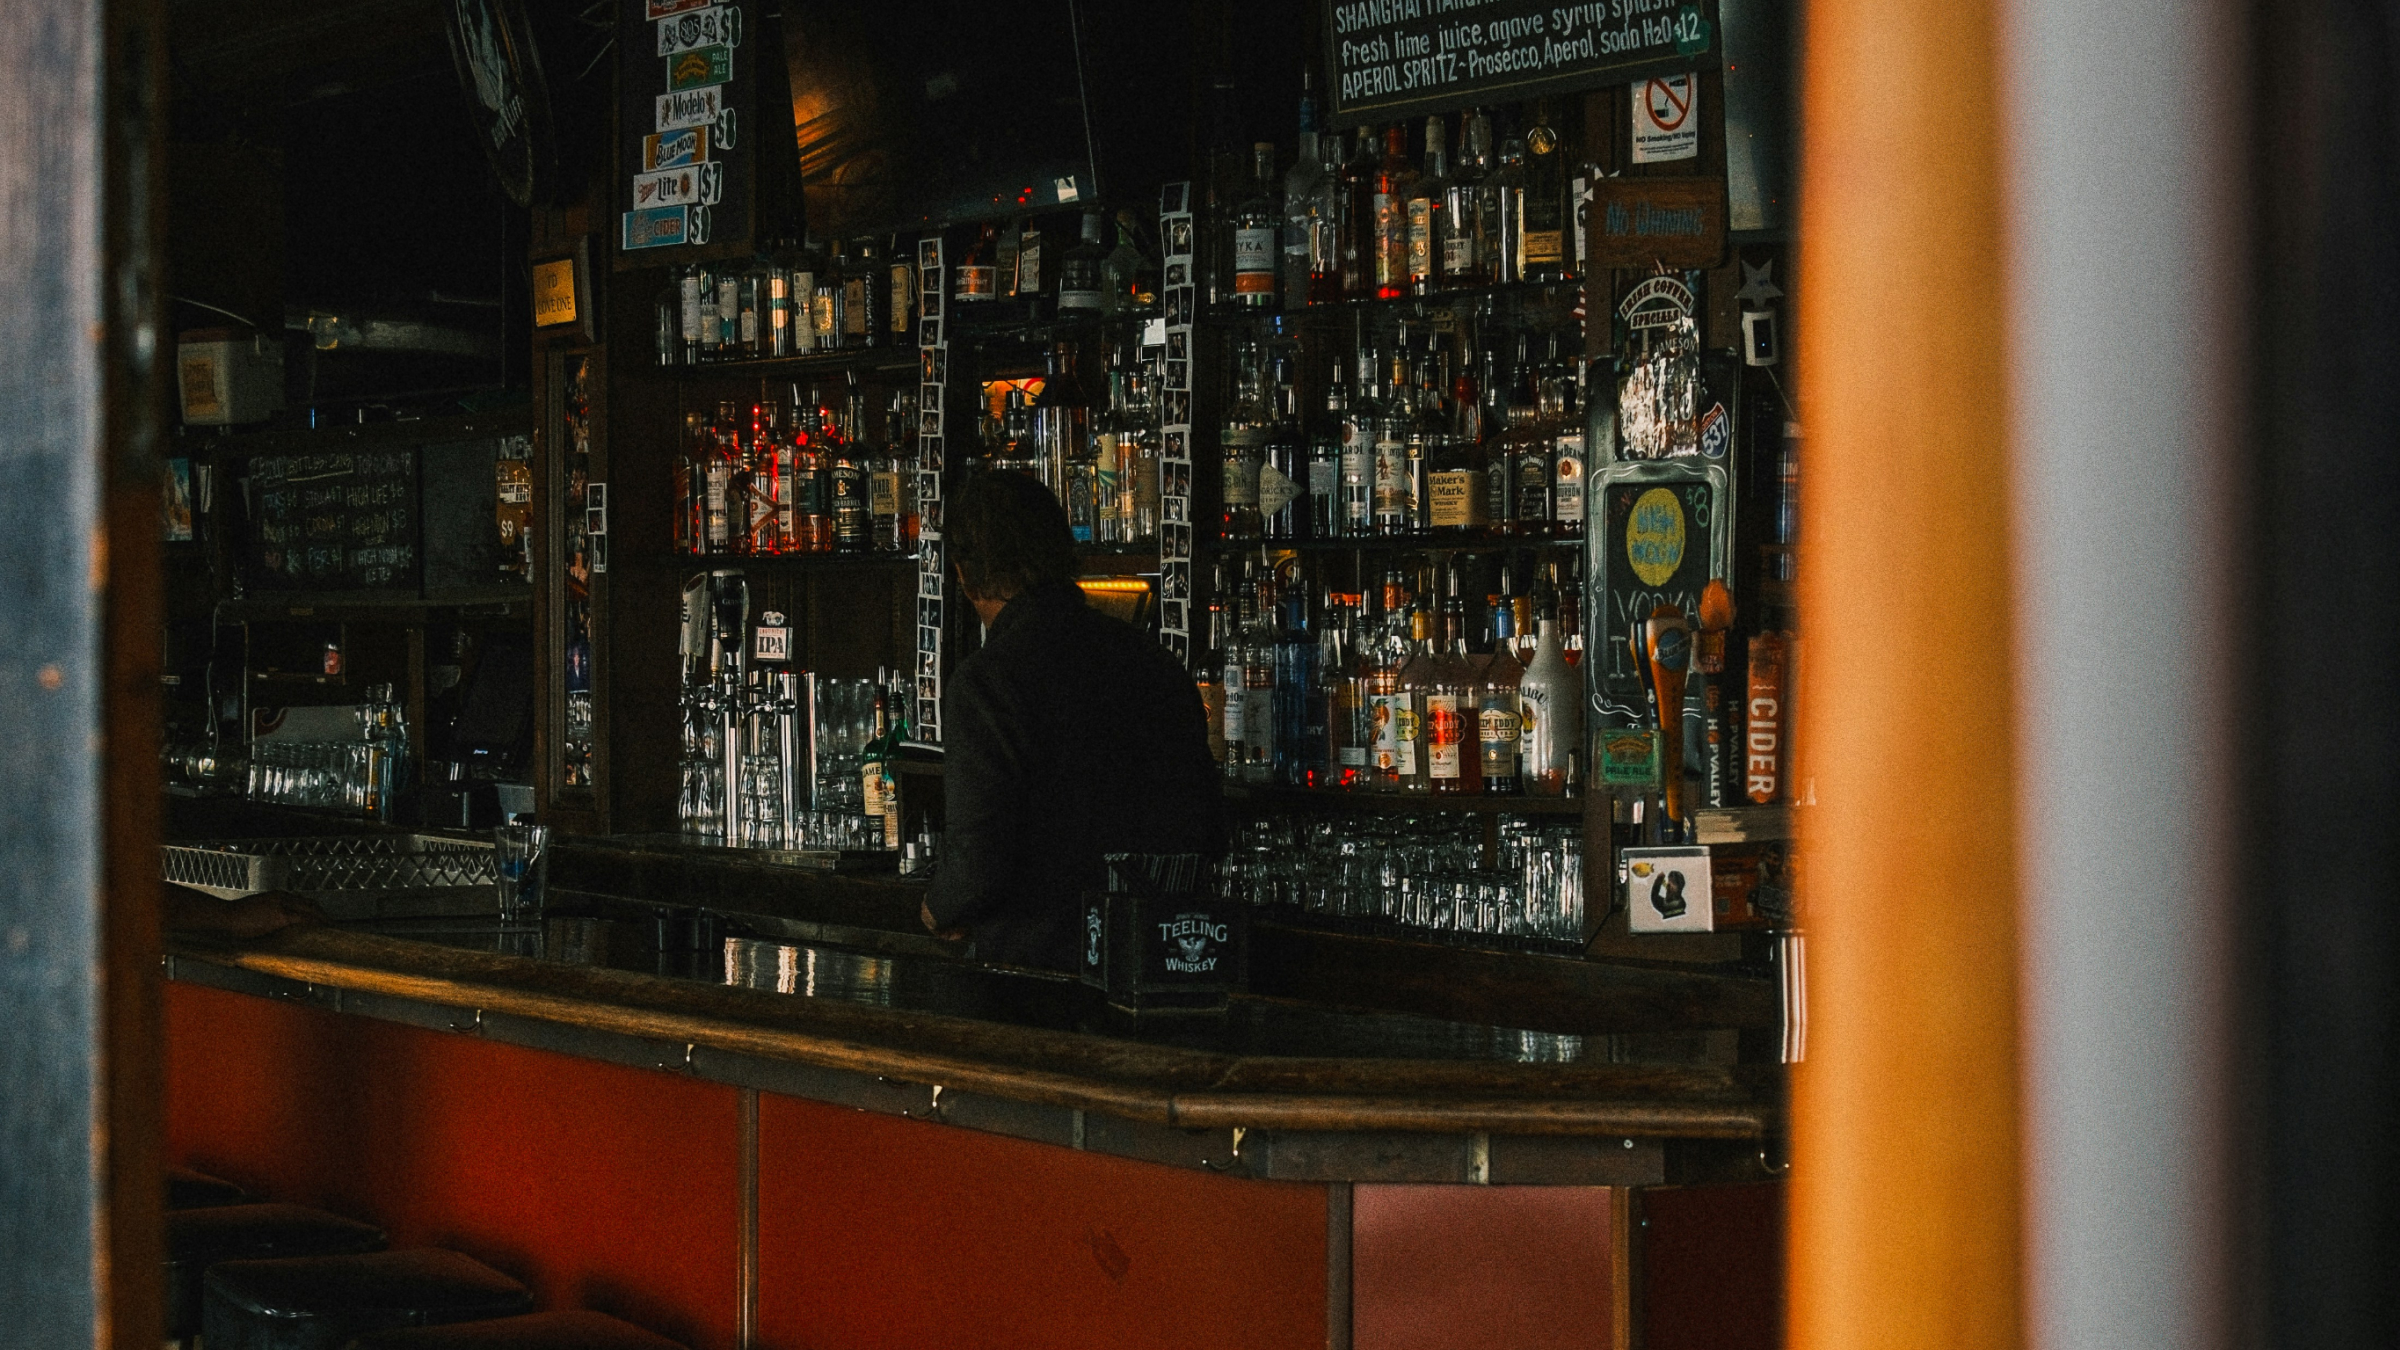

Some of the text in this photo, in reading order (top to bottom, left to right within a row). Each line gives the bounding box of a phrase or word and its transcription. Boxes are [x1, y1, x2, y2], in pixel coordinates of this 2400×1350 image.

[680, 19, 700, 37] 805
[1342, 34, 1390, 67] fresh
[1394, 31, 1430, 59] lime
[1438, 21, 1488, 56] juice,
[1489, 13, 1545, 49] agave
[1552, 2, 1606, 36] syrup
[1673, 13, 1701, 43] $12
[712, 51, 728, 63] PALE
[1342, 65, 1402, 101] APEROL
[1403, 52, 1458, 88] SPRITZ
[1468, 45, 1542, 78] Prosecco,
[1544, 28, 1599, 68] Aperol,
[714, 64, 726, 75] ALE
[673, 92, 705, 120] Modelo
[656, 135, 696, 166] BLUE MOON
[658, 177, 678, 201] Lite
[702, 163, 722, 203] $7
[654, 218, 681, 236] CIDER
[557, 296, 572, 311] ONE
[1621, 280, 1693, 317] IRISH COFFEE
[1632, 309, 1680, 327] SPECIALS
[1656, 337, 1696, 355] JAMESON
[1702, 414, 1727, 454] 537
[1429, 475, 1465, 486] Maker's
[1438, 487, 1465, 497] Mark
[1686, 486, 1710, 528] $8
[501, 519, 514, 538] $9
[757, 636, 785, 654] IPA
[1749, 697, 1778, 794] CIDER
[1157, 919, 1229, 943] TEELING
[1165, 956, 1218, 973] WHISKEY
